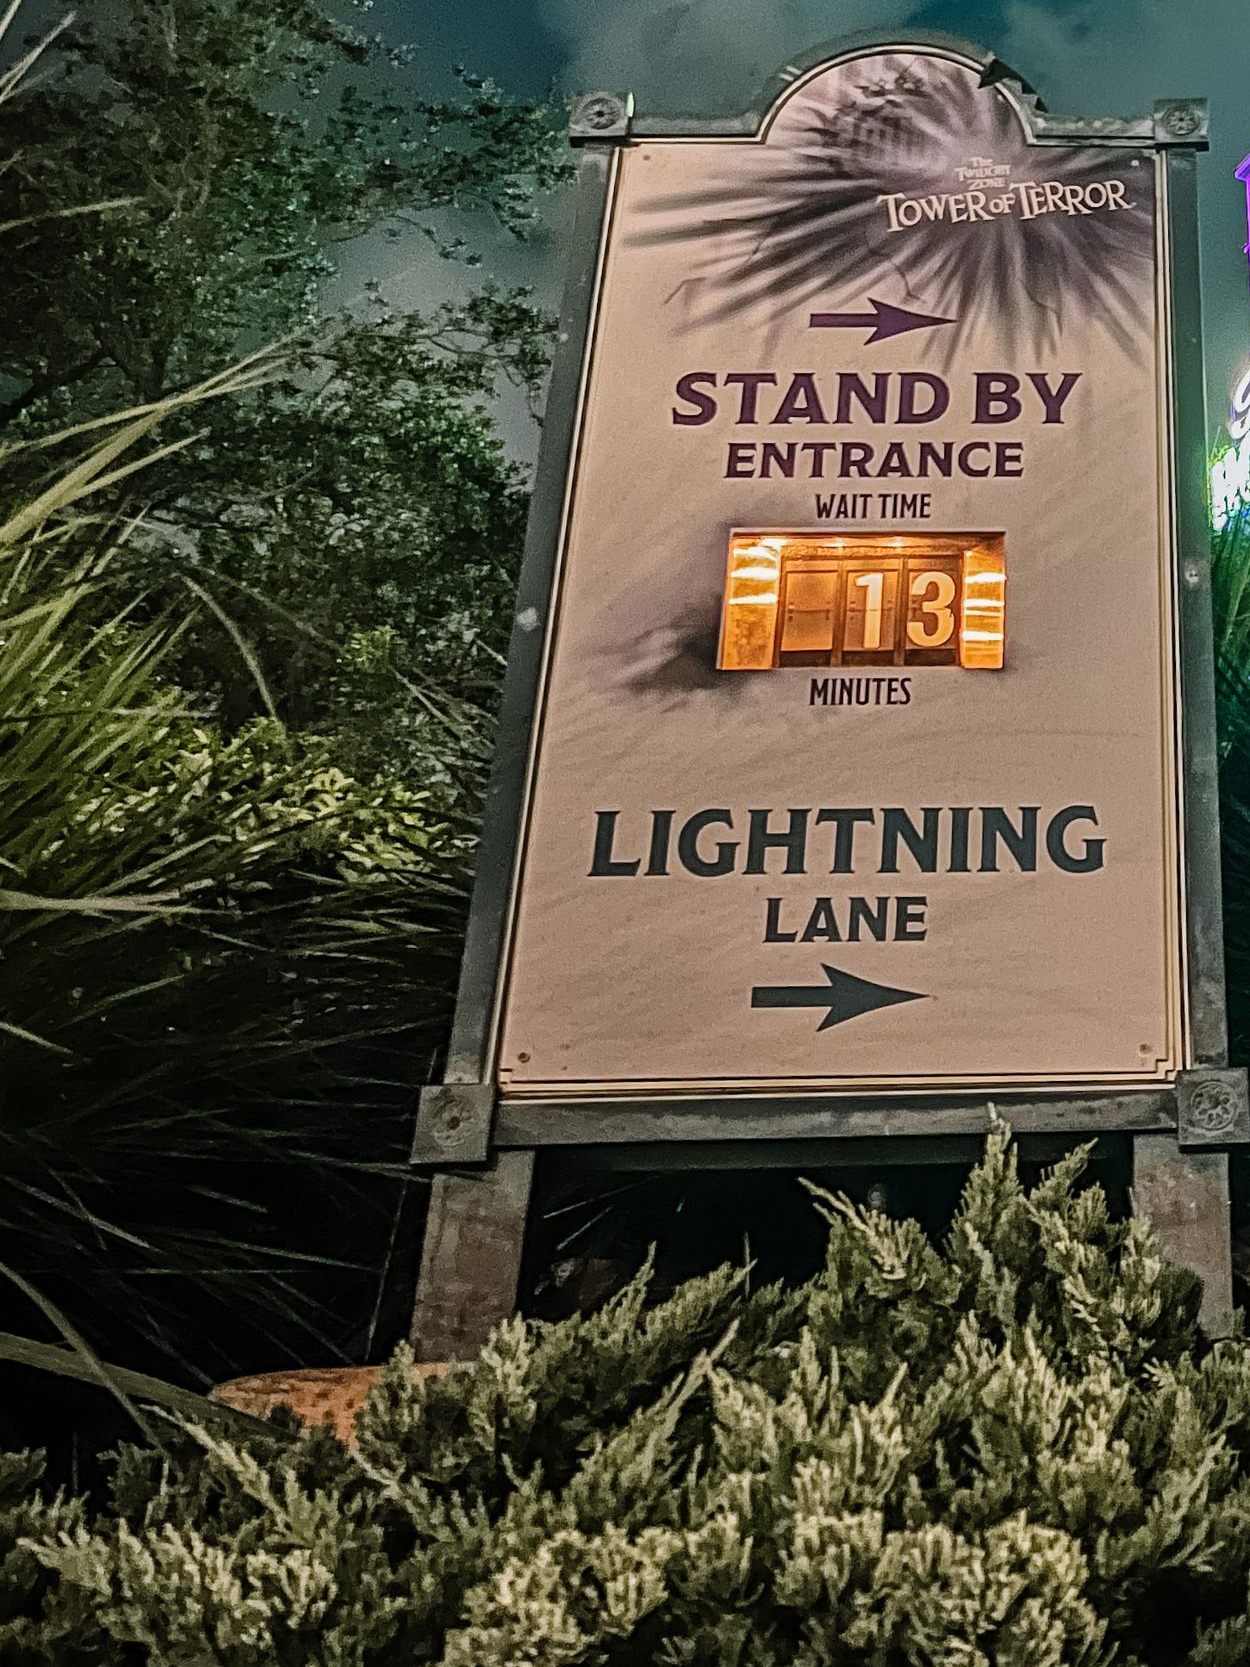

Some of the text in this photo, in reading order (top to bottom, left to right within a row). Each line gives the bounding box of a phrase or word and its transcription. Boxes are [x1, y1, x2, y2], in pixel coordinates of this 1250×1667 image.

[877, 190, 995, 233] TOWER
[1009, 180, 1132, 221] TERROR
[671, 371, 1083, 426] STAND BY
[723, 440, 1024, 480] ENTRANCE
[814, 492, 932, 520] WAIT TIME
[854, 571, 956, 649] 13
[809, 677, 912, 707] MINUTES
[586, 804, 1108, 877] LIGHTNING
[762, 895, 929, 944] LANE
